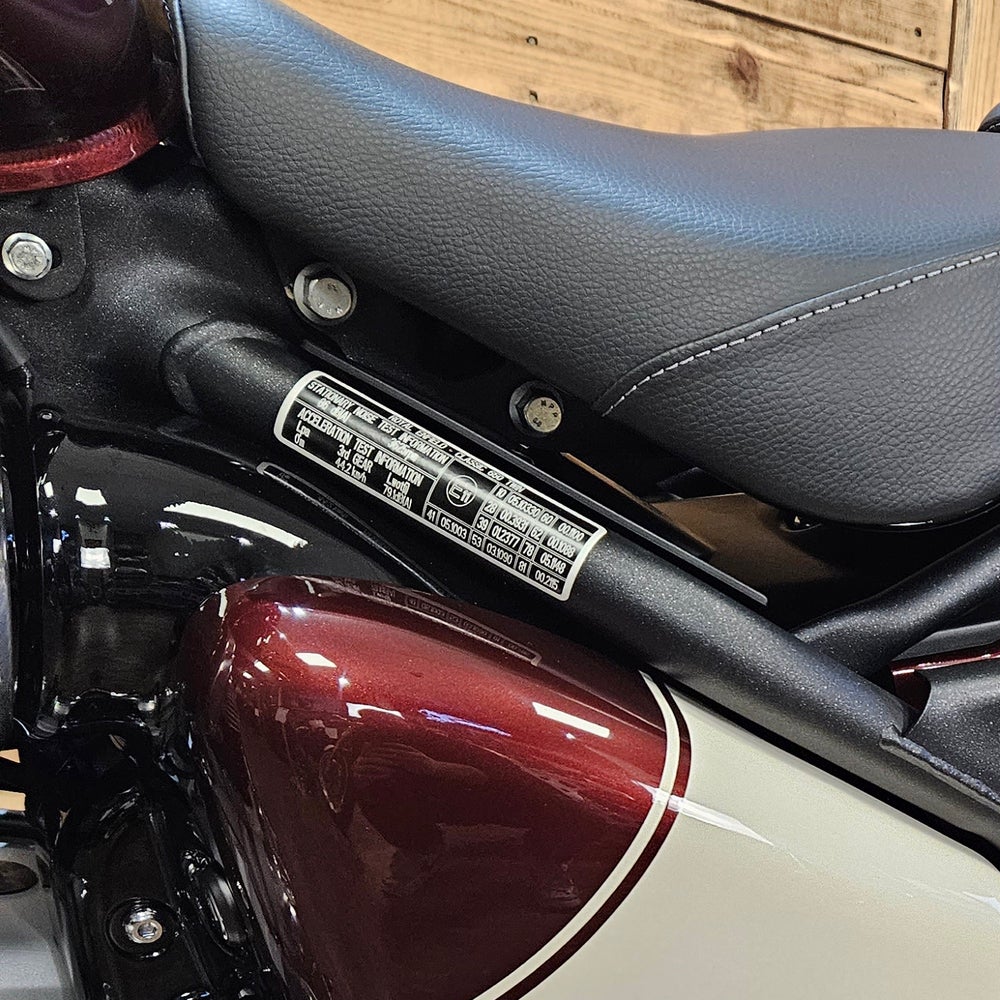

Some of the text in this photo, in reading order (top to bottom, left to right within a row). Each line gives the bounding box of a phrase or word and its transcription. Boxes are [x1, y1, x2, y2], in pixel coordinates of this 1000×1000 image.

[308, 381, 449, 464] STATIONARY NOISE TEST INFORMATION
[297, 407, 424, 487] ACCELERATION TEST INFORMATION
[337, 444, 374, 473] 3rd GEAR
[496, 487, 508, 498] 10
[484, 501, 497, 514] 28
[427, 509, 436, 522] 41
[477, 516, 489, 531] 39
[471, 533, 482, 548] 53
[530, 527, 543, 541] 62
[523, 541, 535, 556] 78
[518, 561, 528, 573] 81
